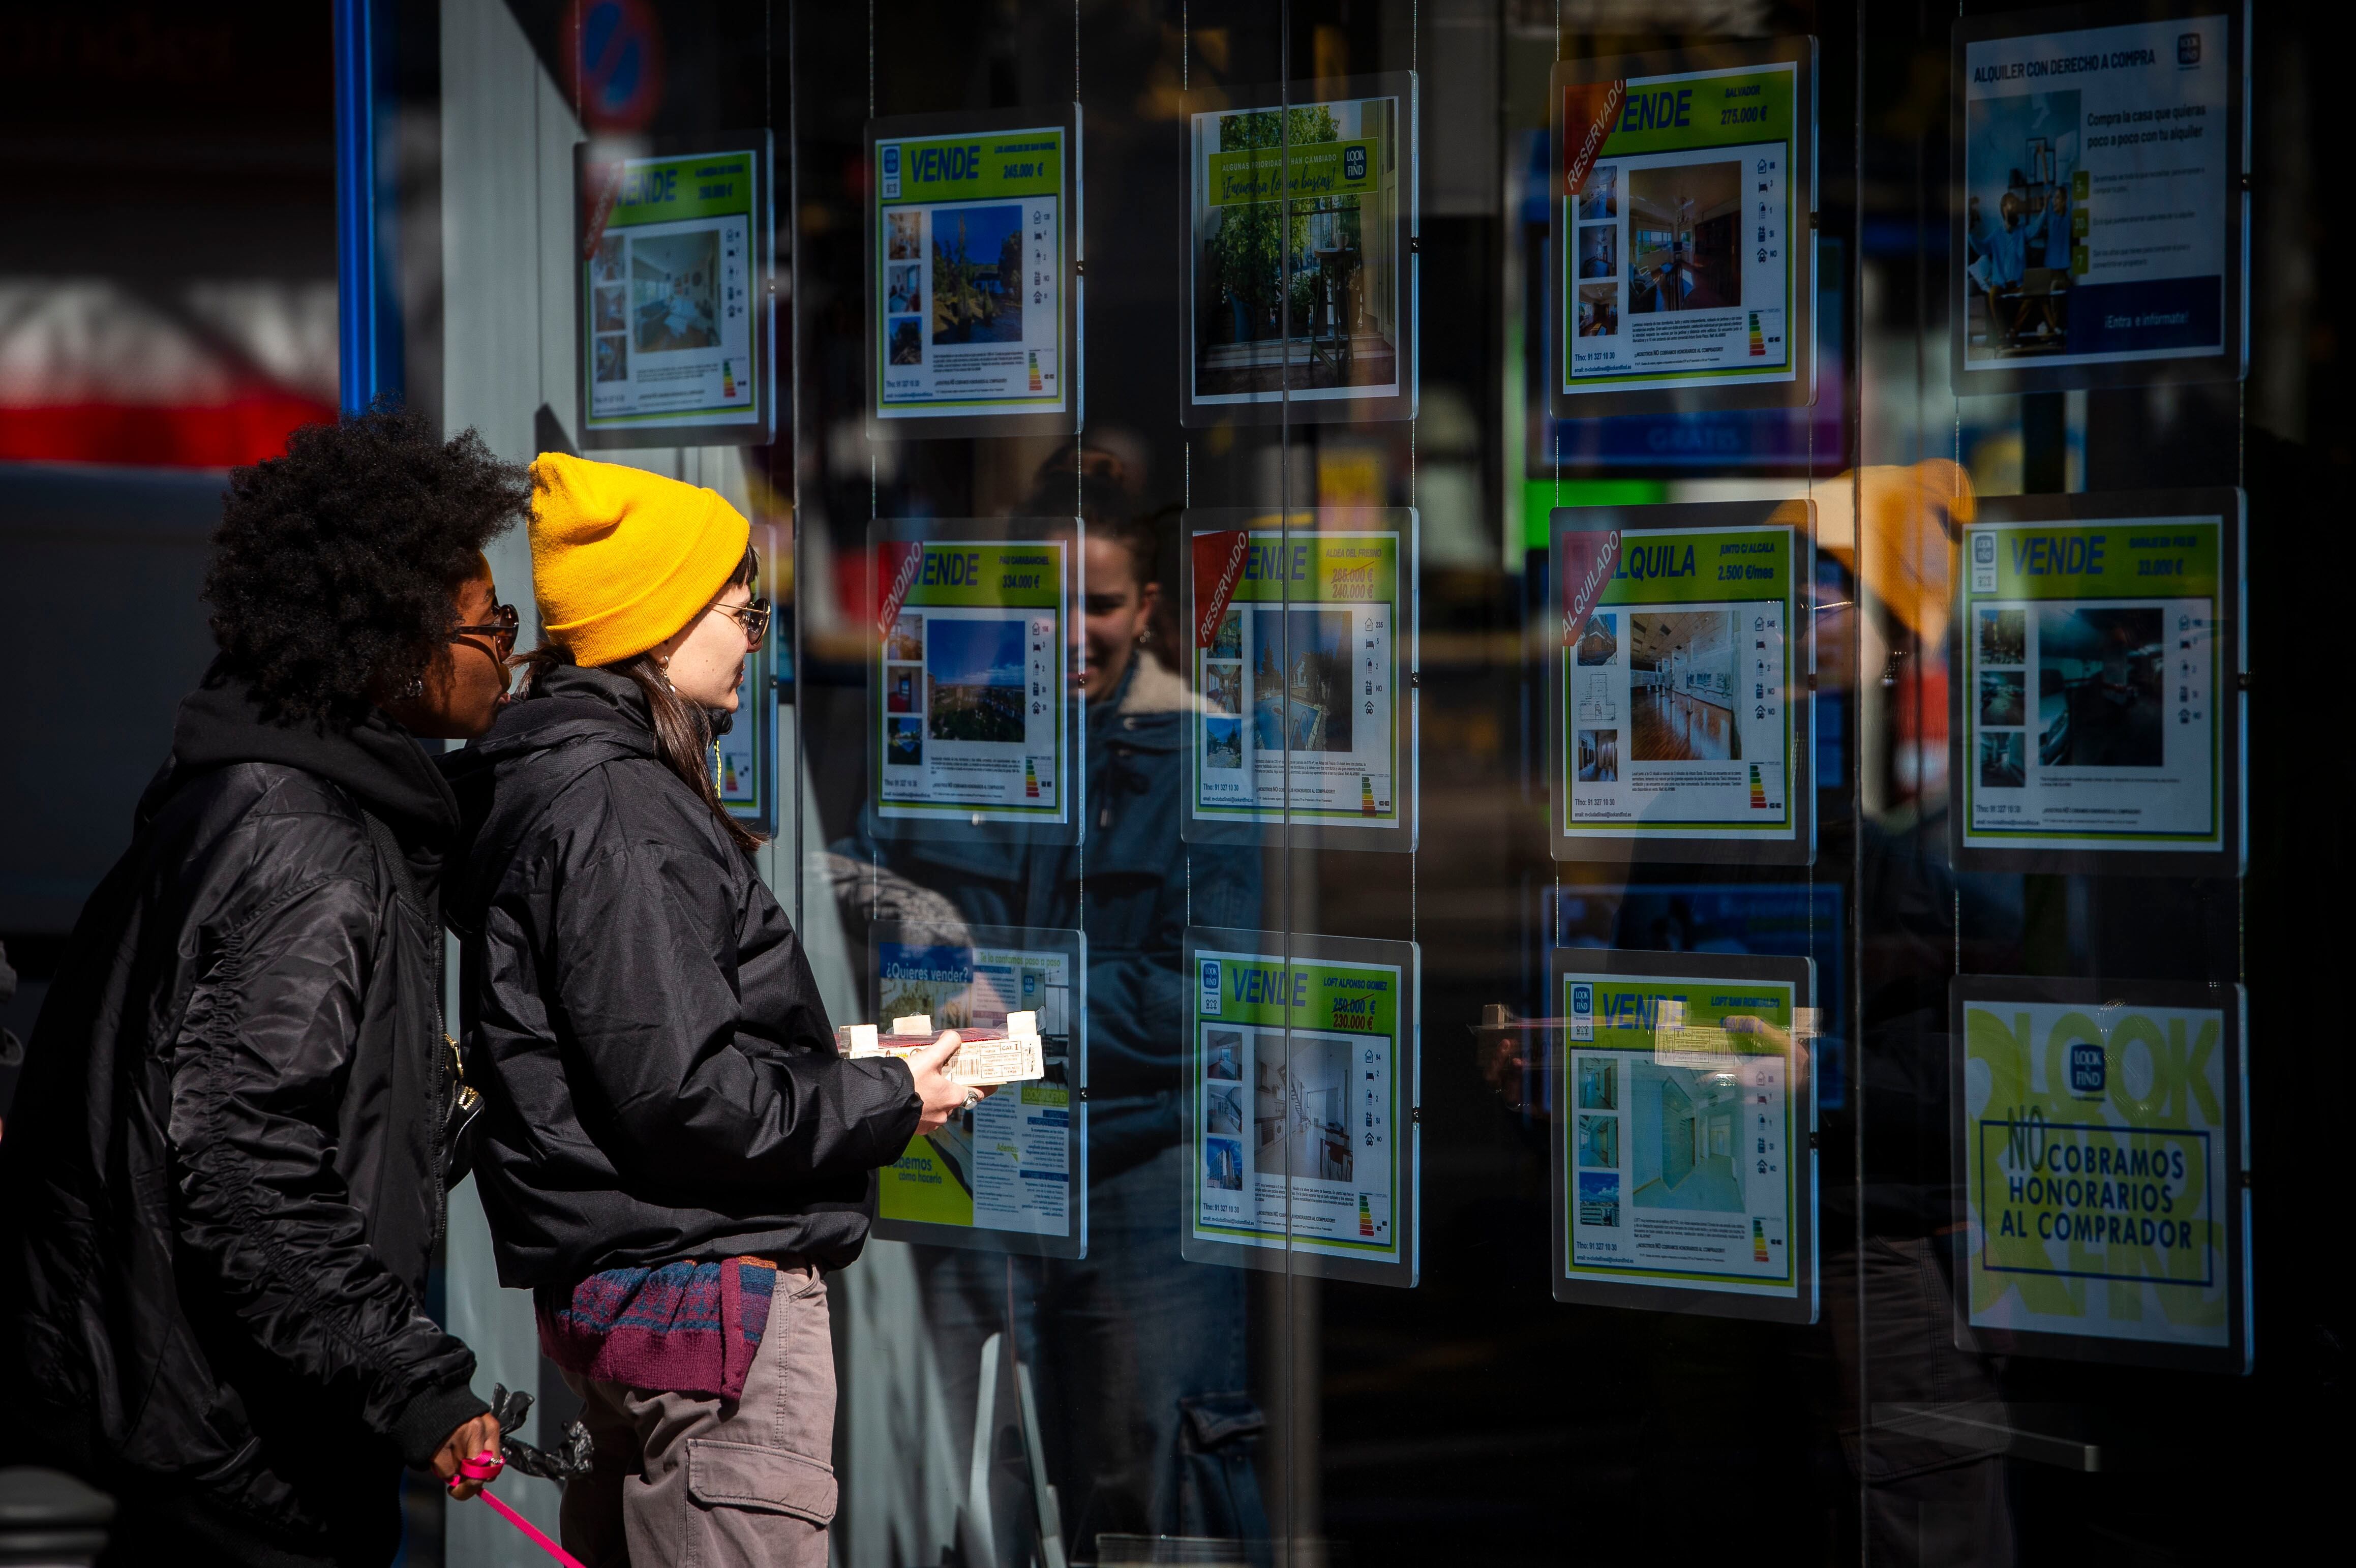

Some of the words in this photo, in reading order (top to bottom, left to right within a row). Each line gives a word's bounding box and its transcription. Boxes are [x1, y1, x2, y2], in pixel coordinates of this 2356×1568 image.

[1975, 63, 2025, 83] ALQUILER
[2027, 59, 2049, 77] CON
[2050, 55, 2099, 75] DERECHO
[2101, 54, 2109, 69] A
[2112, 50, 2156, 68] COMPRA
[1725, 85, 1760, 98] SALVADOR
[1720, 106, 1758, 125] 275.000
[1760, 105, 1767, 122] €
[2088, 111, 2121, 128] Compra
[2123, 110, 2130, 122] la
[2132, 109, 2153, 122] casa
[2155, 109, 2171, 122] que
[2173, 105, 2206, 120] quieras
[1567, 79, 1624, 190] RESERVADO
[2088, 135, 2108, 149] poco
[2110, 136, 2116, 145] a
[2118, 134, 2138, 147] poco
[2141, 132, 2157, 142] con
[2159, 129, 2168, 141] tu
[2170, 126, 2202, 142] alquiler
[911, 145, 981, 183] VENDE
[1222, 161, 1249, 172] ALGUNAS
[1251, 158, 1283, 169] PRIORIDAD
[1290, 156, 1303, 165] HAN
[1305, 153, 1337, 164] CAMBIADO
[1347, 149, 1365, 162] LOOK
[1037, 162, 1044, 177] €
[1348, 165, 1364, 177] FIND
[1289, 179, 1300, 192] ue
[1326, 549, 1344, 558] ALDEA
[1346, 548, 1356, 558] DEL
[1358, 548, 1382, 558] FRESNO
[2012, 535, 2106, 576] VENDE
[1245, 546, 1307, 580] ENDE
[1612, 545, 1696, 581] LQUILA
[1368, 568, 1374, 583] €
[1718, 564, 1743, 580] 2.500
[1745, 564, 1774, 580] €/mes
[878, 542, 922, 634] VENDIDO
[1003, 574, 1032, 588] 334.000
[1034, 574, 1040, 588] €
[1201, 532, 1246, 642] RESERVADO
[1563, 530, 1619, 640] ALQUILADO
[1332, 584, 1365, 598] 240.000
[1368, 584, 1374, 599] €
[980, 952, 986, 962] Te
[988, 952, 993, 963] lo
[995, 955, 1023, 965] contamos
[1024, 958, 1039, 969] paso
[1046, 959, 1061, 969] paso
[886, 962, 928, 981] ¿Quieres
[931, 966, 969, 982] vender?
[1204, 967, 1217, 975] LOOK
[1206, 978, 1217, 986] FIND
[1233, 968, 1308, 1007] VENDE
[1323, 977, 1338, 987] LOFT
[1339, 978, 1365, 989] ALFONSO
[1367, 981, 1387, 991] GOMEZ
[1576, 990, 1588, 1000] LOOK
[1711, 997, 1728, 1007] LOFT
[1333, 997, 1366, 1014] 250.000
[1370, 1000, 1376, 1015] €
[1577, 1002, 1588, 1010] FIND
[1603, 993, 1687, 1030] VENDE
[1333, 1013, 1366, 1030] 230.000
[1367, 1016, 1374, 1031] €
[2074, 1051, 2101, 1065] LOOK
[2075, 1070, 2100, 1087] FIND
[2007, 1104, 2046, 1171] NO
[2047, 1144, 2184, 1179] COBRAMOS
[887, 1157, 932, 1171] abemos
[898, 1171, 916, 1181] cómo
[918, 1172, 943, 1185] hacerlo
[2009, 1176, 2172, 1213] HONORARIOS
[2000, 1210, 2027, 1239] AL
[2038, 1212, 2191, 1249] COMPRADOR
